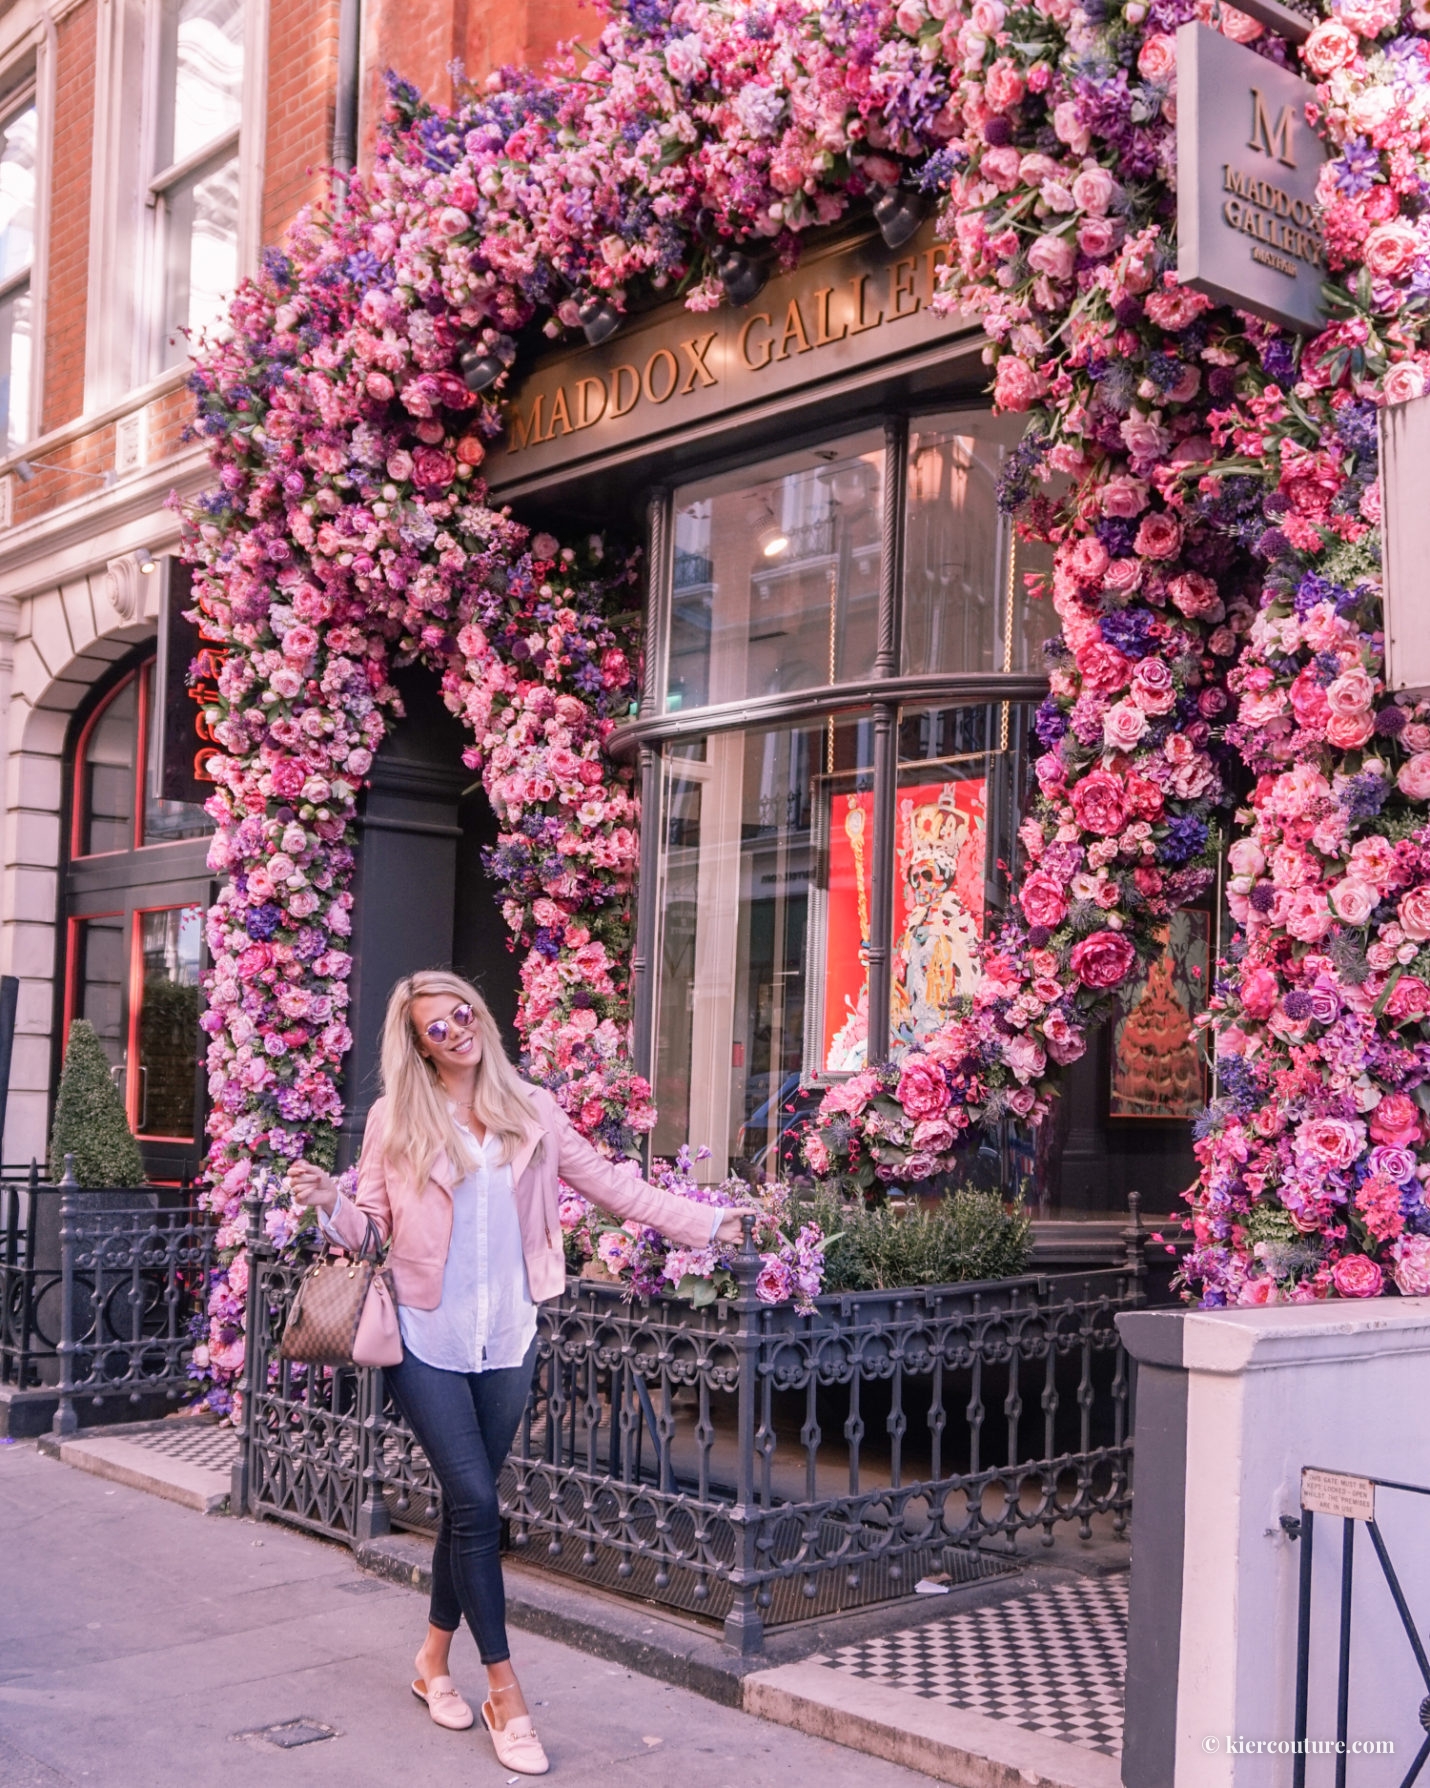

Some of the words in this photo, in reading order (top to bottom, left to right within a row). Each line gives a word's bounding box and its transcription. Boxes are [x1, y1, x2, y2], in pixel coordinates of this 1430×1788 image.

[1248, 87, 1296, 169] M
[1223, 163, 1321, 236] MADDOX
[1223, 199, 1322, 269] GALLERY
[1252, 246, 1297, 278] MAYFAIR
[507, 331, 718, 455] MADDOX
[1307, 1482, 1321, 1490] KEPT
[1324, 1485, 1346, 1495] LOCKED
[1323, 1476, 1338, 1485] GATE
[1340, 1479, 1357, 1488] MUST
[1303, 1491, 1325, 1499] WHILST
[1328, 1494, 1338, 1502] THE
[1341, 1497, 1370, 1508] PREMISES
[1342, 1505, 1352, 1513] USE
